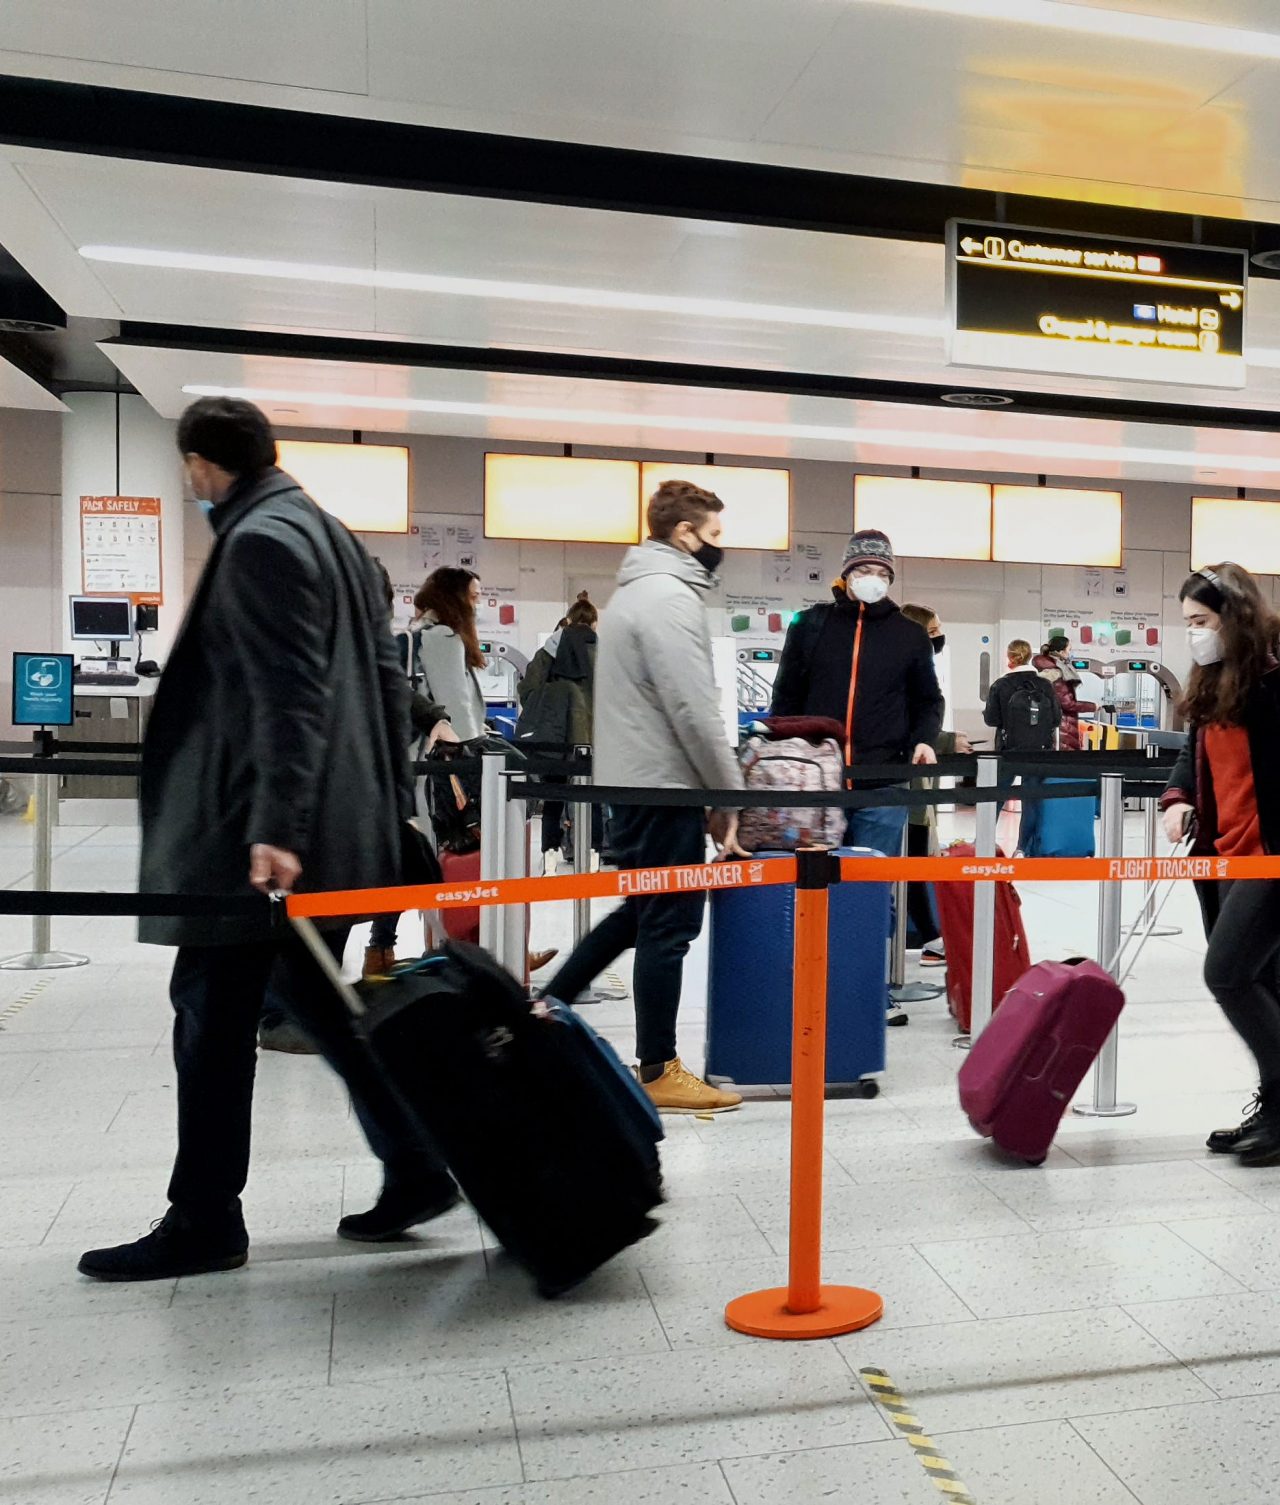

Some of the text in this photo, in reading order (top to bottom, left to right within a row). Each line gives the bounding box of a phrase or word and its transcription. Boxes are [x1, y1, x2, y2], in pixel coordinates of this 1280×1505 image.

[82, 499, 140, 512] PACK SAFELY
[961, 863, 1015, 876] easyJet
[1109, 859, 1210, 879] FLIGHT TRACKER
[617, 864, 743, 893] FLIGHT TRACKER
[435, 886, 499, 902] easyJet
